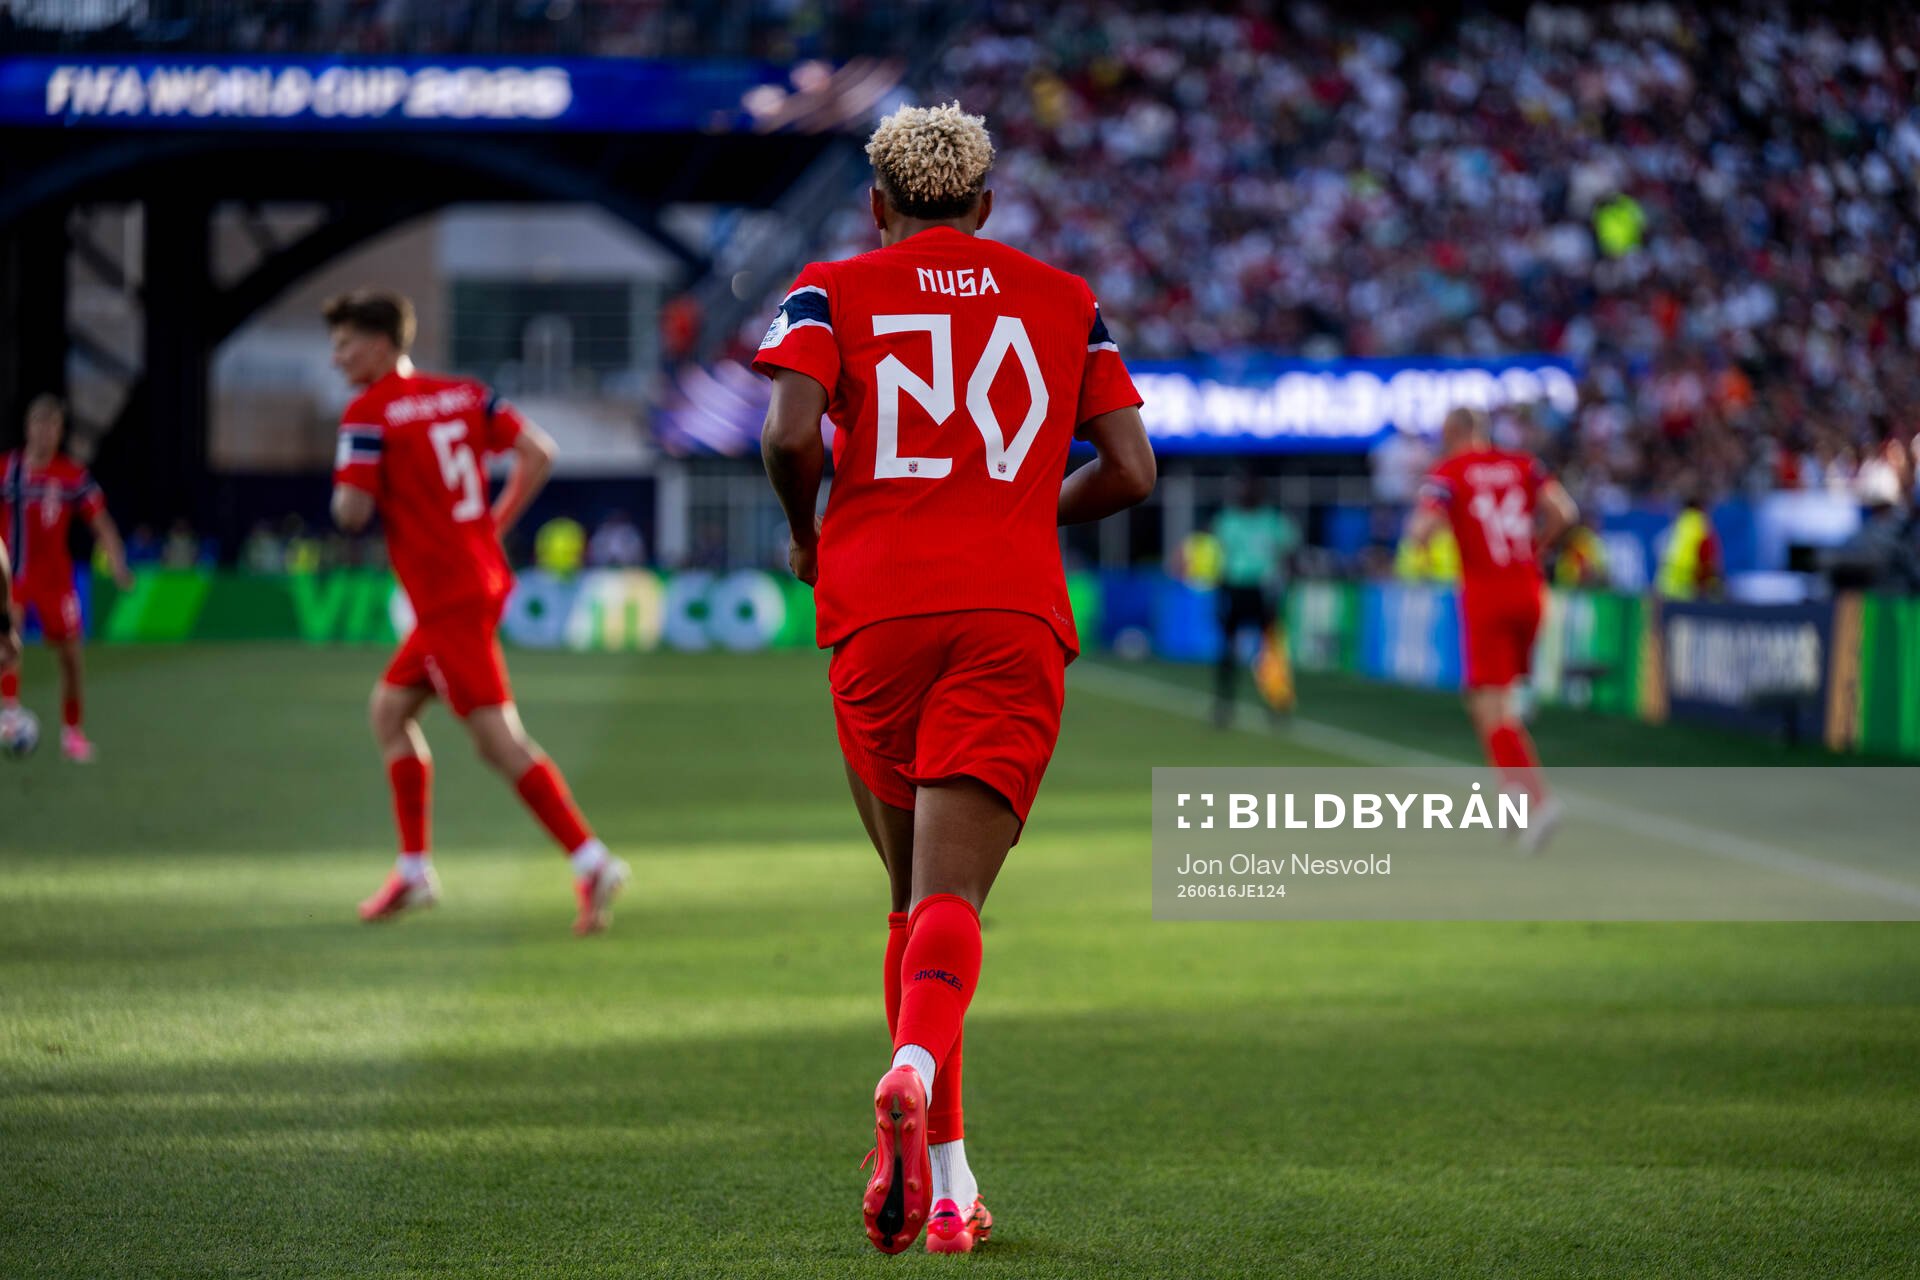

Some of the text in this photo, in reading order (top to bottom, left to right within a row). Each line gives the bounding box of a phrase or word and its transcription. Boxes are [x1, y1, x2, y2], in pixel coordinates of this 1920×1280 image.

[46, 66, 147, 116] FIFA
[148, 66, 310, 118] WORLD
[311, 66, 404, 118] CUP
[916, 267, 1000, 297] NUSA
[872, 313, 1049, 482] 20
[428, 419, 483, 522] 5
[1470, 486, 1534, 566] 14
